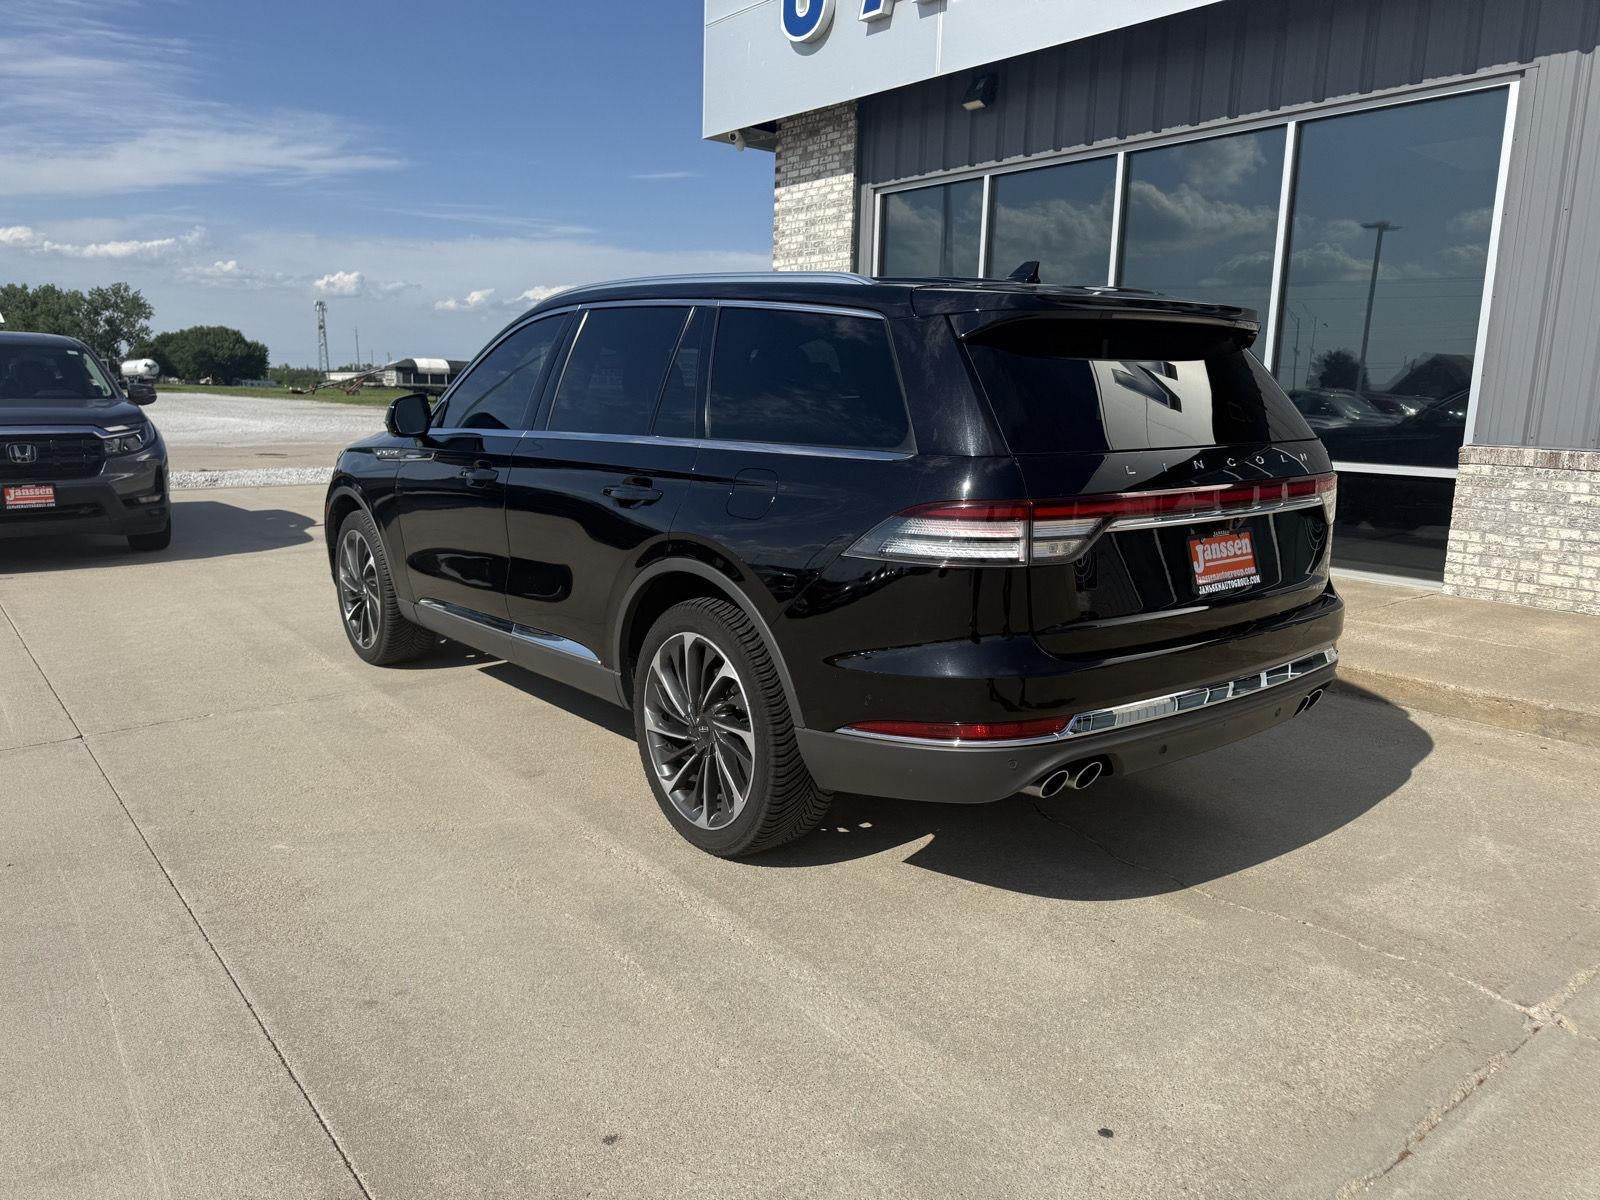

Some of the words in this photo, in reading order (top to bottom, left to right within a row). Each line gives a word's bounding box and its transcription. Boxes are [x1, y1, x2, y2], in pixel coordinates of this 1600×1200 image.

[1125, 453, 1308, 475] LINCOLN
[5, 487, 54, 501] Janssen
[1193, 538, 1252, 574] Janssen
[1199, 574, 1261, 595] JANSSENAUTOGROUP.COM
